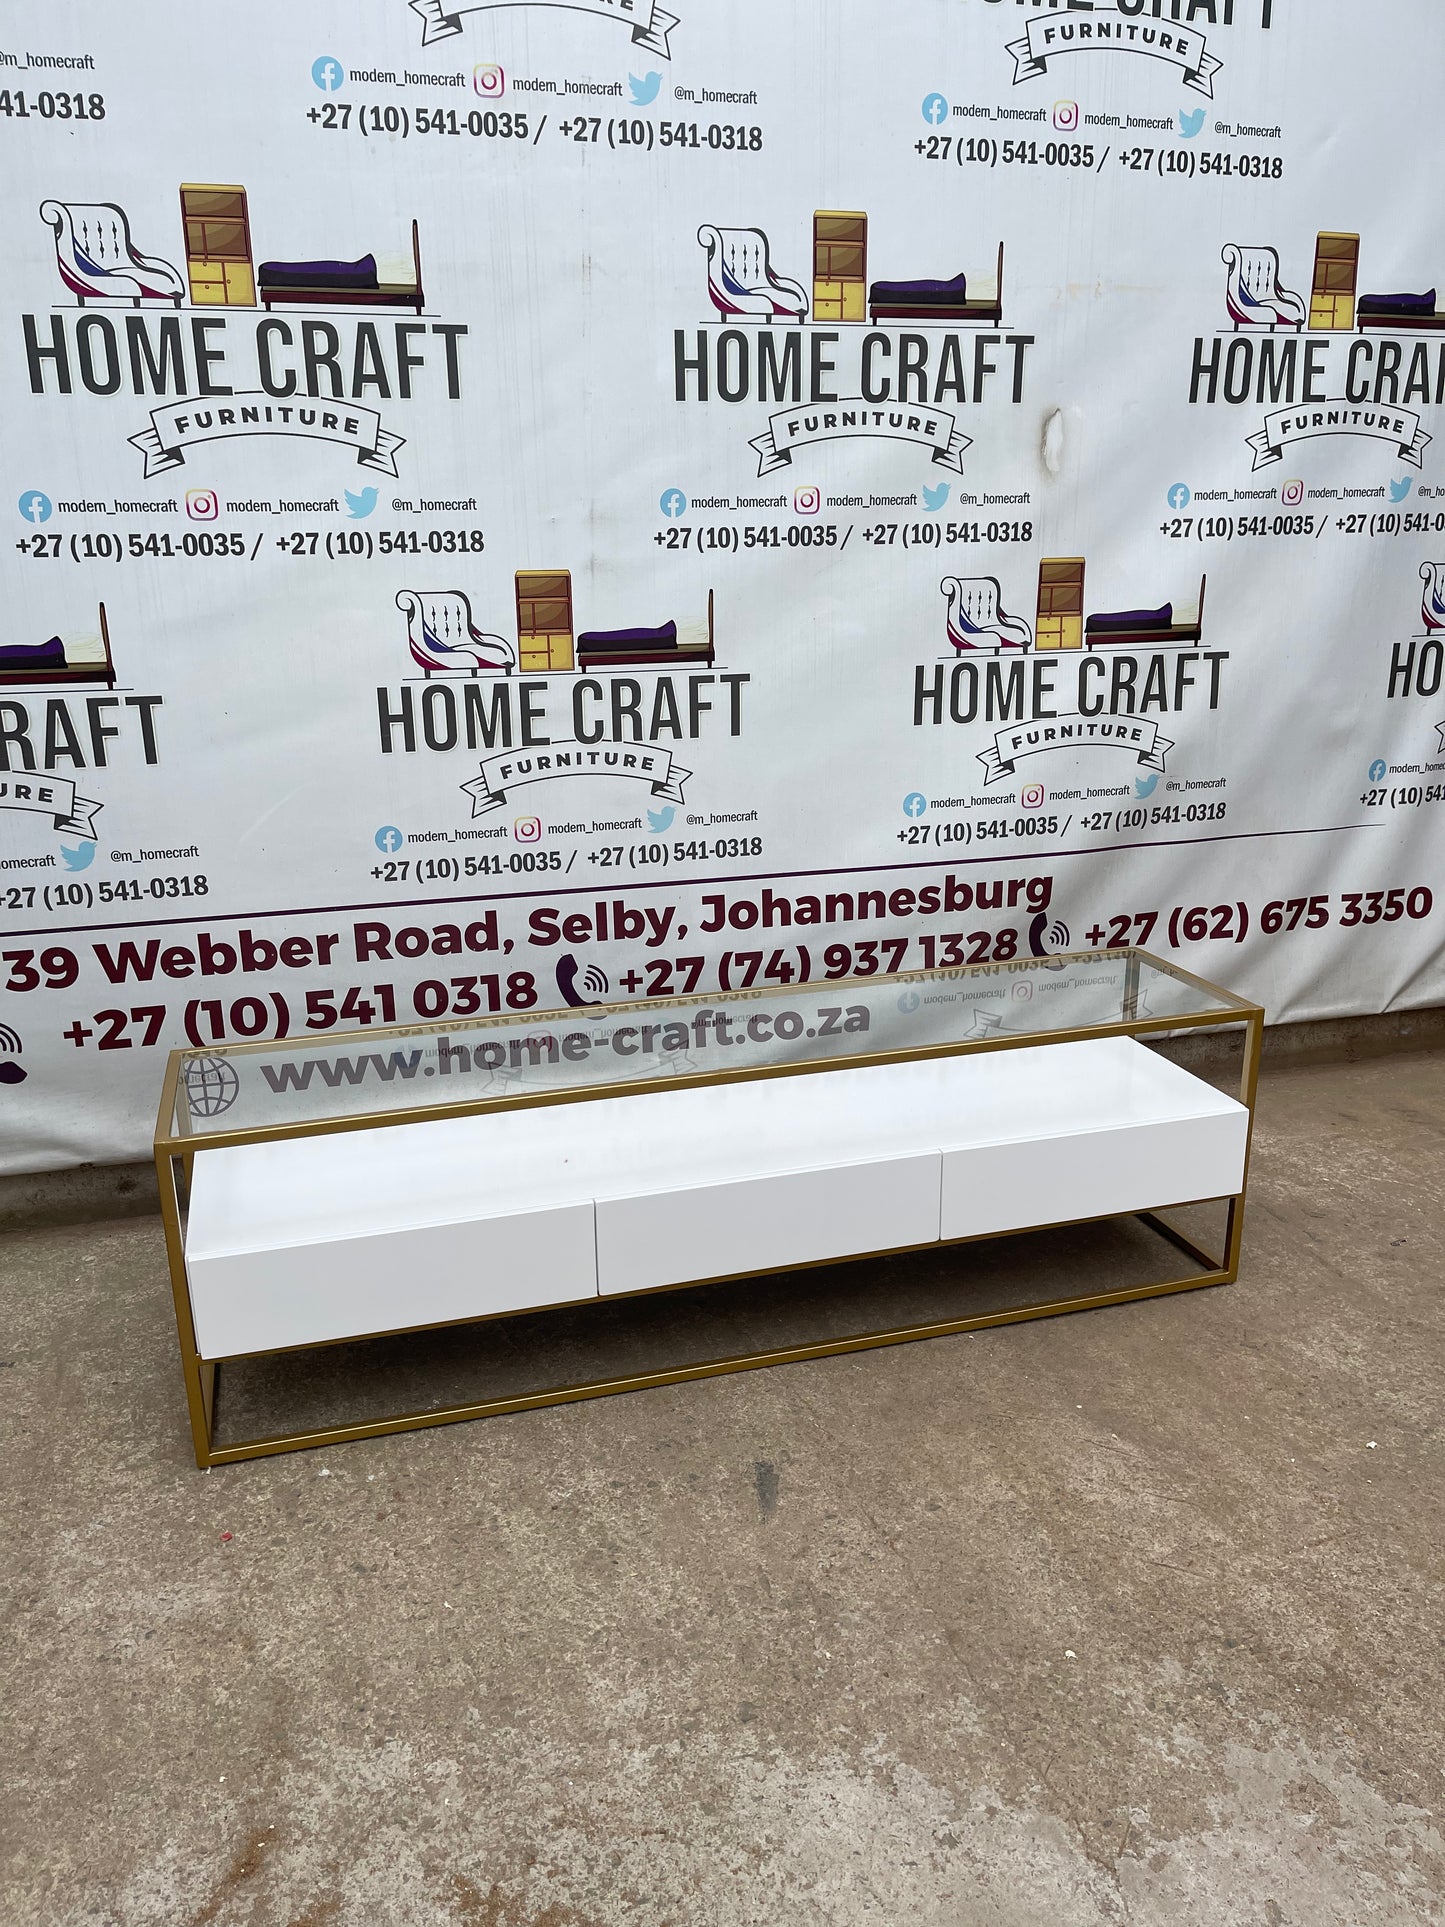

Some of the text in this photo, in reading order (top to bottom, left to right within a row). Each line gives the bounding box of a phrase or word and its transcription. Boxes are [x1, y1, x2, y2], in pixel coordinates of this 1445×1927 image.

[1043, 23, 1188, 57] FURNITURE
[307, 103, 351, 129] +27
[359, 105, 409, 138] (10)
[416, 108, 528, 138] 541-0035
[560, 117, 601, 142] +27
[608, 119, 653, 151] (10)
[660, 122, 762, 151] 541-0318
[915, 136, 952, 159] +27
[957, 138, 997, 167] (10)
[1002, 140, 1093, 167] 541-0035
[1119, 148, 1154, 170] +27
[1158, 150, 1195, 178] (10)
[1200, 153, 1282, 178] 541-0318
[22, 314, 468, 399] HOME CRAFT
[674, 330, 1035, 403] HOME CRAFT
[1189, 338, 1329, 404] HOME
[174, 407, 359, 434] FURNITURE
[788, 412, 937, 436] FURNITURE
[1281, 411, 1404, 434] FURNITURE
[16, 534, 62, 557] +27
[71, 534, 122, 562] (10)
[129, 533, 245, 557] 541-0035
[277, 533, 318, 554] +27
[326, 532, 373, 559] (10)
[379, 530, 484, 553] 541-0318
[654, 528, 691, 549] +27
[697, 527, 738, 553] (10)
[744, 526, 837, 547] 541-0035
[863, 524, 897, 544] +27
[903, 524, 941, 548] (10)
[946, 522, 1032, 543] 541-0318
[1160, 519, 1193, 538] +27
[1198, 517, 1233, 541] (10)
[1238, 516, 1313, 536] 541-0035
[1336, 515, 1367, 533] +27
[1370, 514, 1400, 537] (10)
[914, 652, 1229, 727] HOME CRAFT
[377, 674, 750, 755] HOME CRAFT
[1012, 724, 1144, 751] FURNITURE
[500, 752, 656, 781] FURNITURE
[1360, 789, 1387, 806] +27
[1391, 787, 1422, 808] (10)
[897, 825, 930, 844] +27
[935, 823, 971, 846] (10)
[976, 816, 1057, 839] 541-0035
[1081, 812, 1112, 830] +27
[1116, 809, 1147, 832] (10)
[1151, 802, 1226, 824] 541-0318
[0, 855, 56, 869] omecraft
[371, 861, 409, 881] +27
[416, 858, 459, 883] (10)
[465, 851, 561, 876] 541-0035
[588, 847, 623, 866] +27
[629, 844, 668, 868] (10)
[674, 837, 762, 861] 541-0318
[44, 883, 93, 911] (10)
[99, 875, 208, 902] 541-0318
[2, 873, 1053, 992] 39 Webber Road, Selby, Johannesburg
[1085, 887, 1432, 949] +27 (62) 675 3350
[620, 956, 704, 996] +27
[719, 945, 810, 992] (74)
[824, 938, 908, 978] 937
[919, 928, 1018, 971] 1328
[63, 1005, 166, 1050] +27
[184, 992, 291, 1048] (10)
[306, 984, 396, 1029] 541
[413, 972, 539, 1019] 0318
[259, 1005, 871, 1093] www.home-craft.co.za
